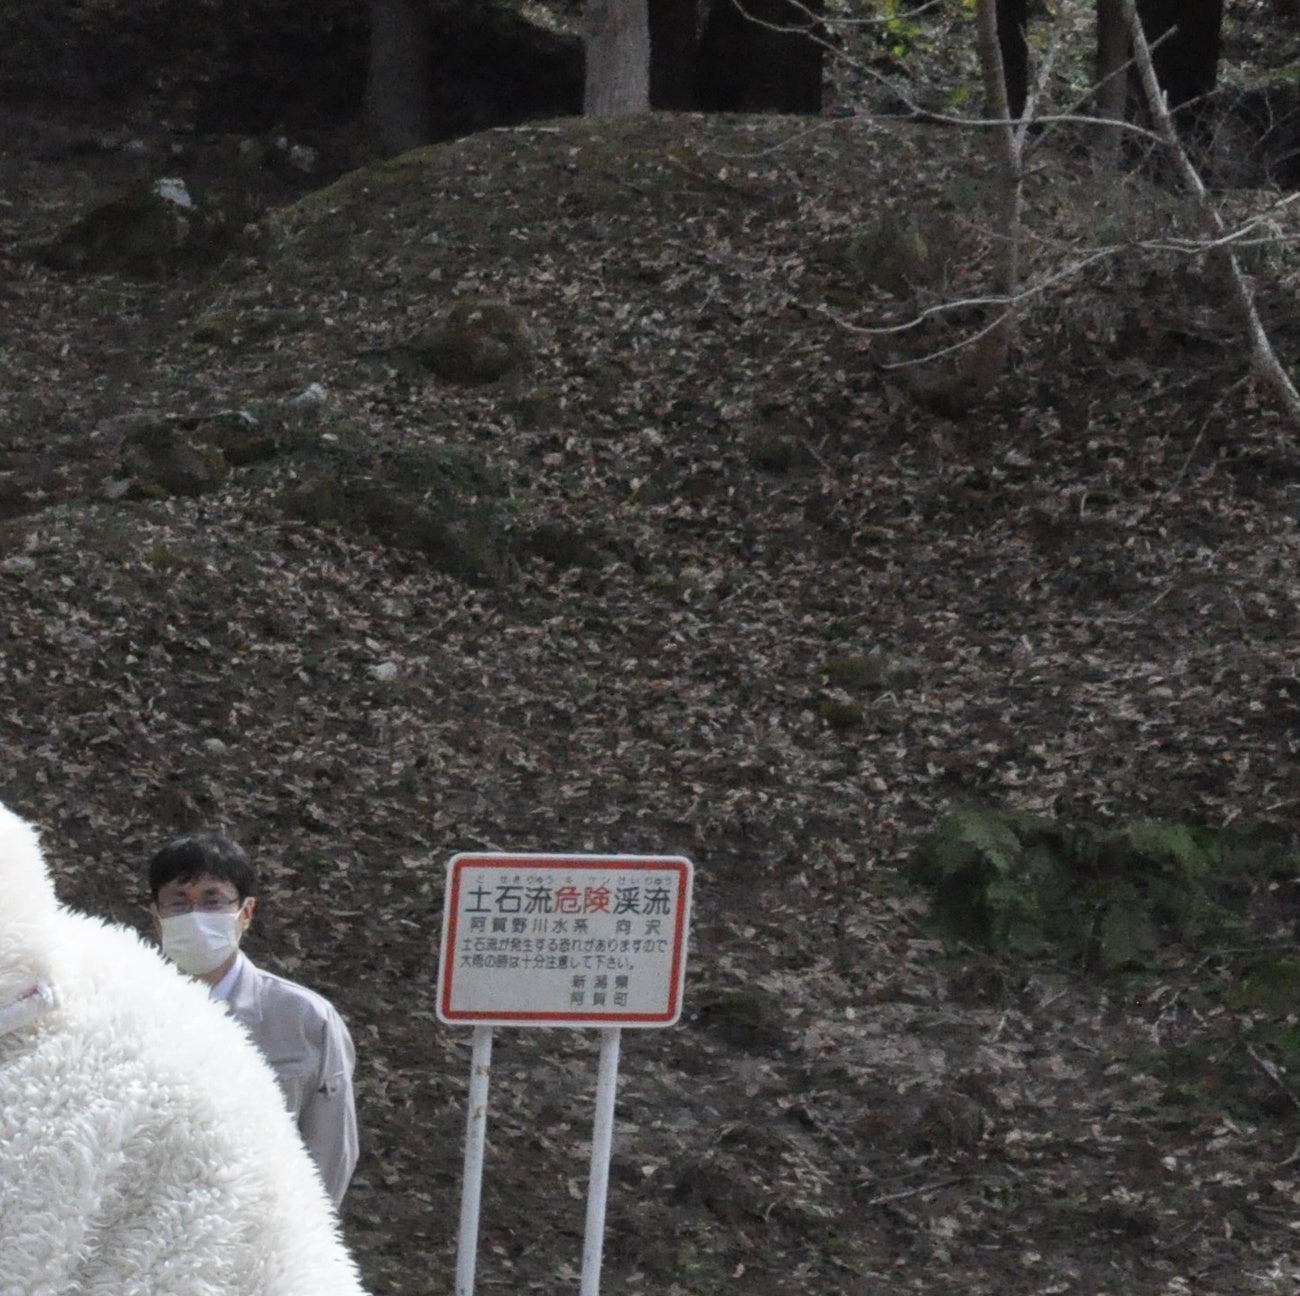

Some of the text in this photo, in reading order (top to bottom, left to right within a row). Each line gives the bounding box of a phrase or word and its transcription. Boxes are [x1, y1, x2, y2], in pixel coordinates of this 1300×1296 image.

[464, 885, 671, 915] 土石流危険渓流
[470, 916, 589, 934] 阿賀野川水系
